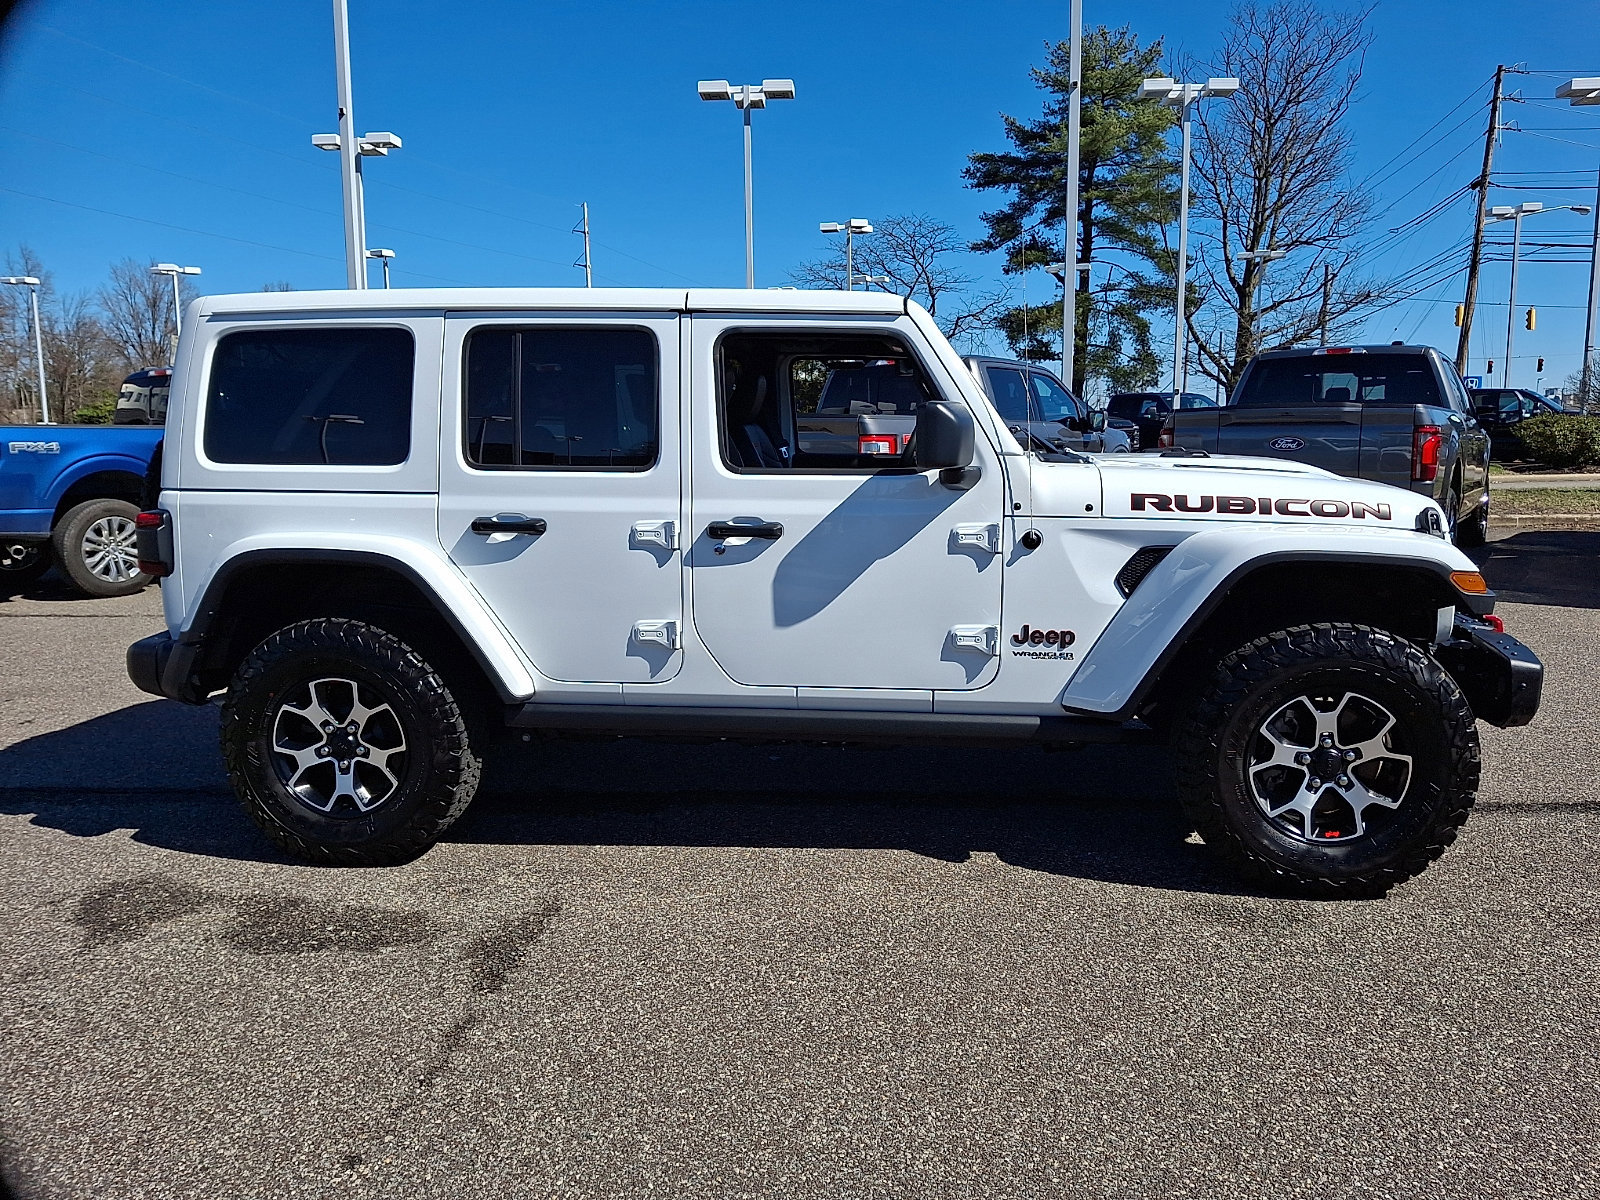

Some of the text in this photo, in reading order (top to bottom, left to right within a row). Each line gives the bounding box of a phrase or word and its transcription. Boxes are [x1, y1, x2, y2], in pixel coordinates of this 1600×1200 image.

[8, 441, 60, 454] FX4
[1130, 493, 1391, 520] RUBICON
[1011, 625, 1076, 649] Jeep
